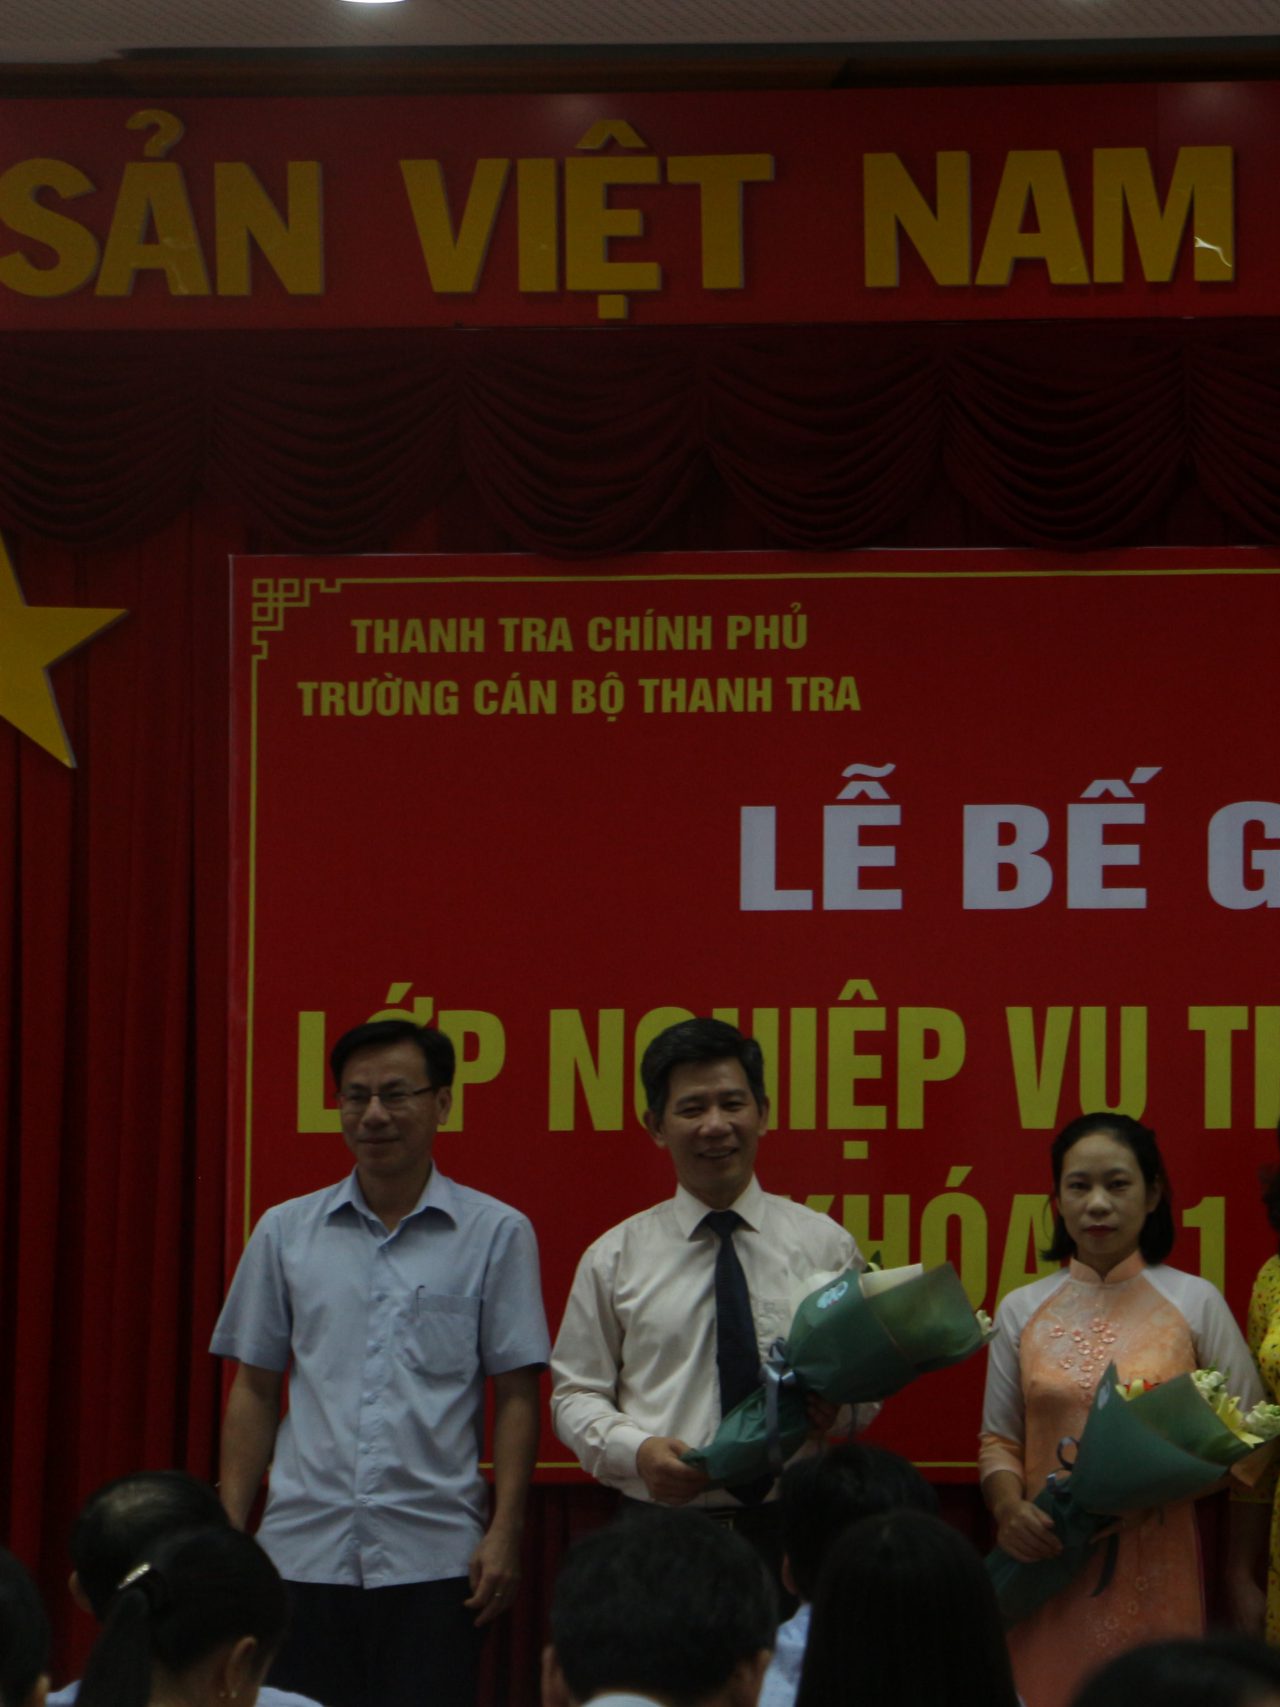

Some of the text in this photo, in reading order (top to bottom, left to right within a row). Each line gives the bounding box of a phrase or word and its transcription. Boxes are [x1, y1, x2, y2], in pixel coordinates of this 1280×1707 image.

[0, 110, 324, 298] SẢN
[400, 119, 774, 319] VIỆT
[864, 146, 1235, 287] NAM
[298, 672, 861, 722] TRƯỜNG CÁN BỘ THANH TRA
[352, 603, 807, 654] THANH TRA CHÍNH PHỦ
[740, 763, 902, 911] LỄ
[962, 766, 1162, 910] BẾ
[783, 1166, 1063, 1312] HÓA
